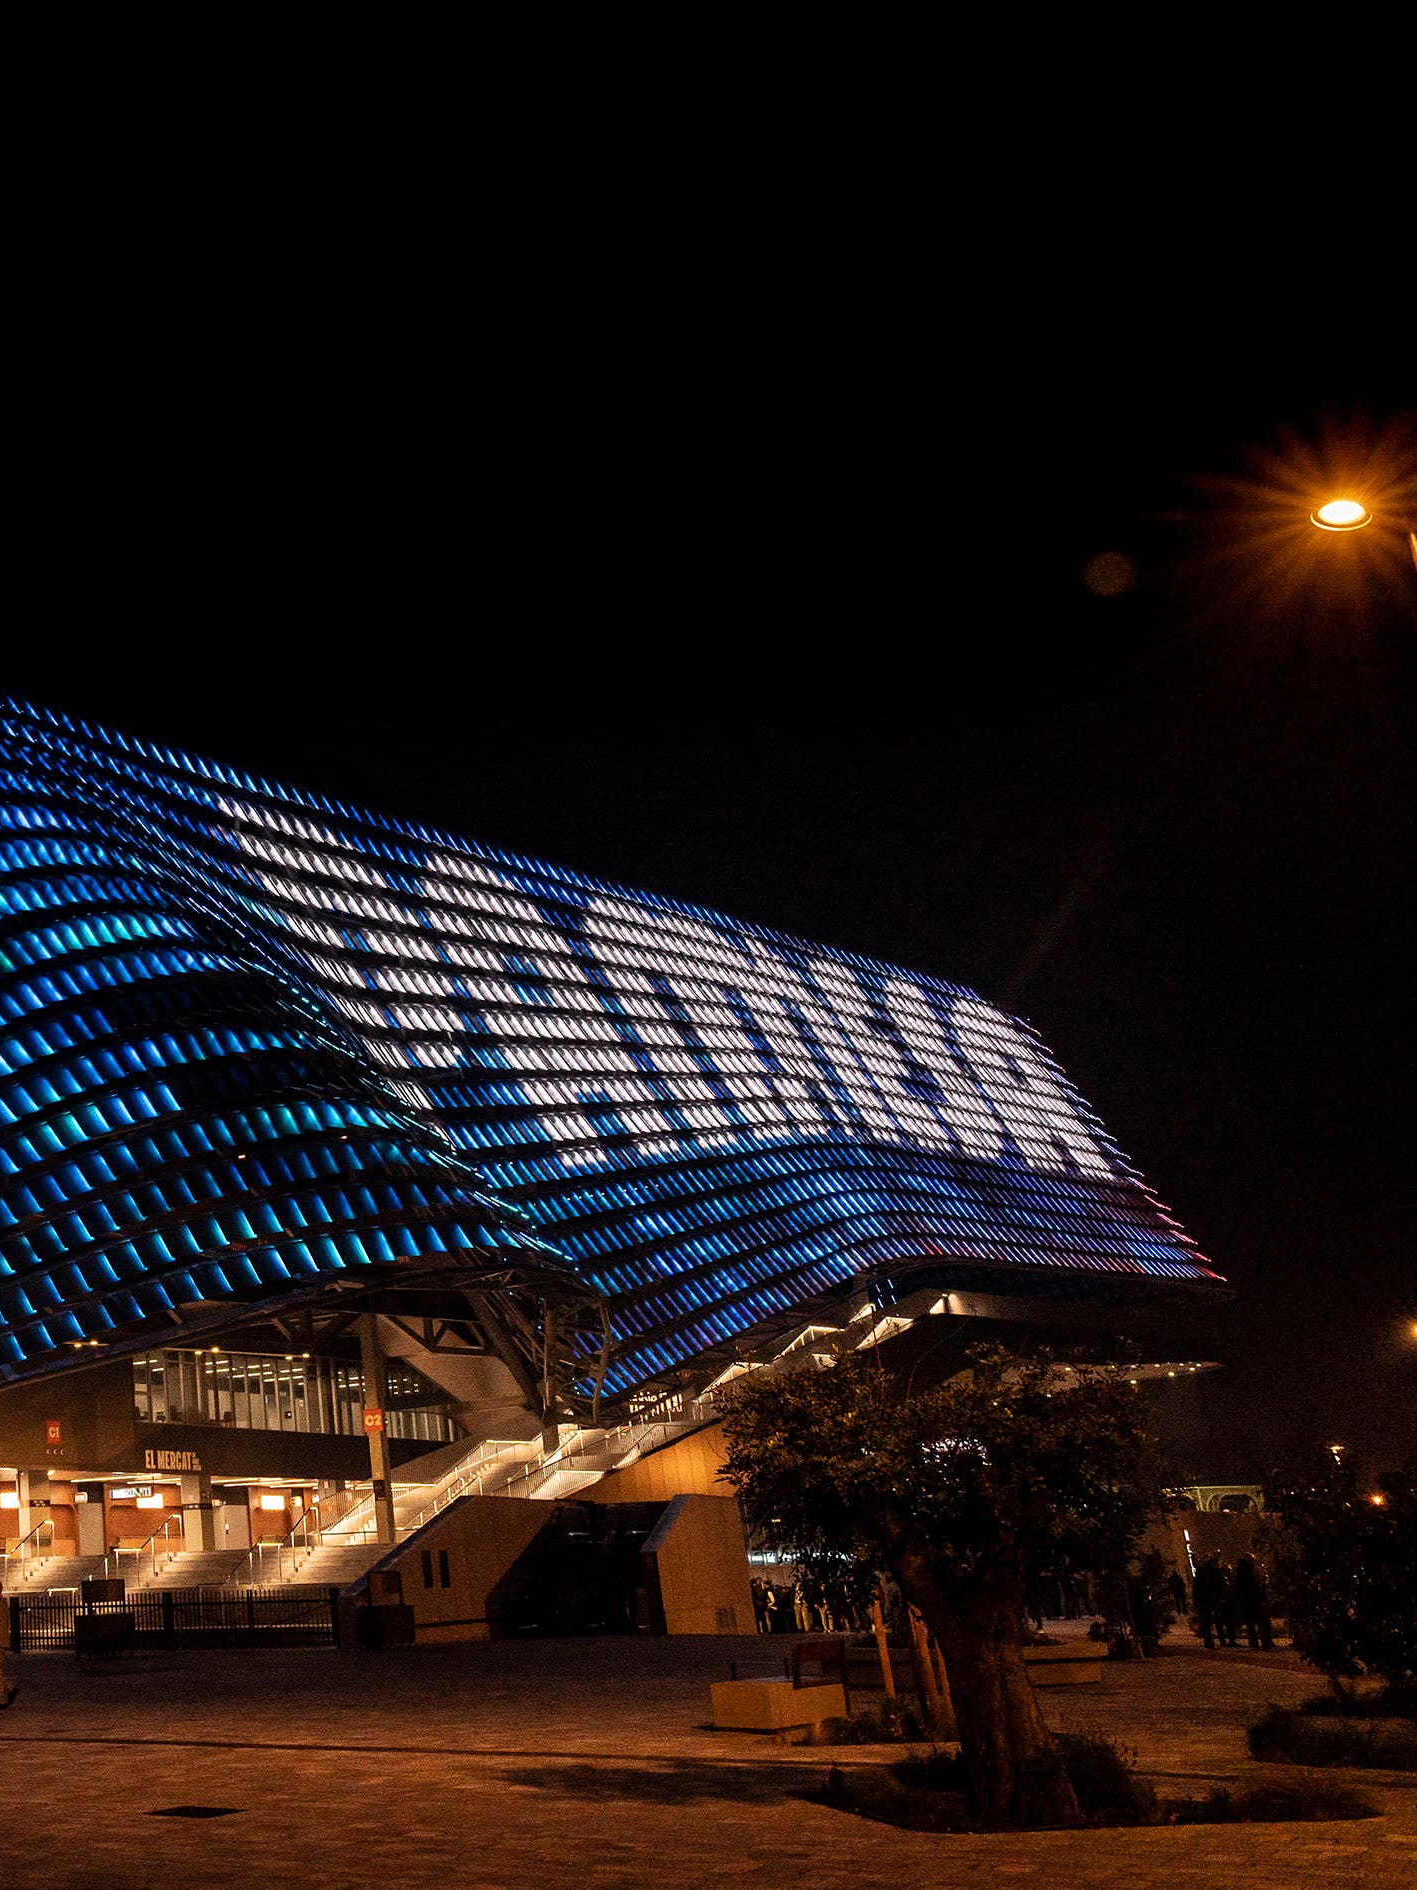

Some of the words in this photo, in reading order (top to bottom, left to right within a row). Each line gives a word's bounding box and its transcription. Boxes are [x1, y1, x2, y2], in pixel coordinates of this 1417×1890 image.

[363, 1414, 382, 1427] C2
[145, 1449, 156, 1469] EL
[157, 1450, 192, 1470] MERCAT
